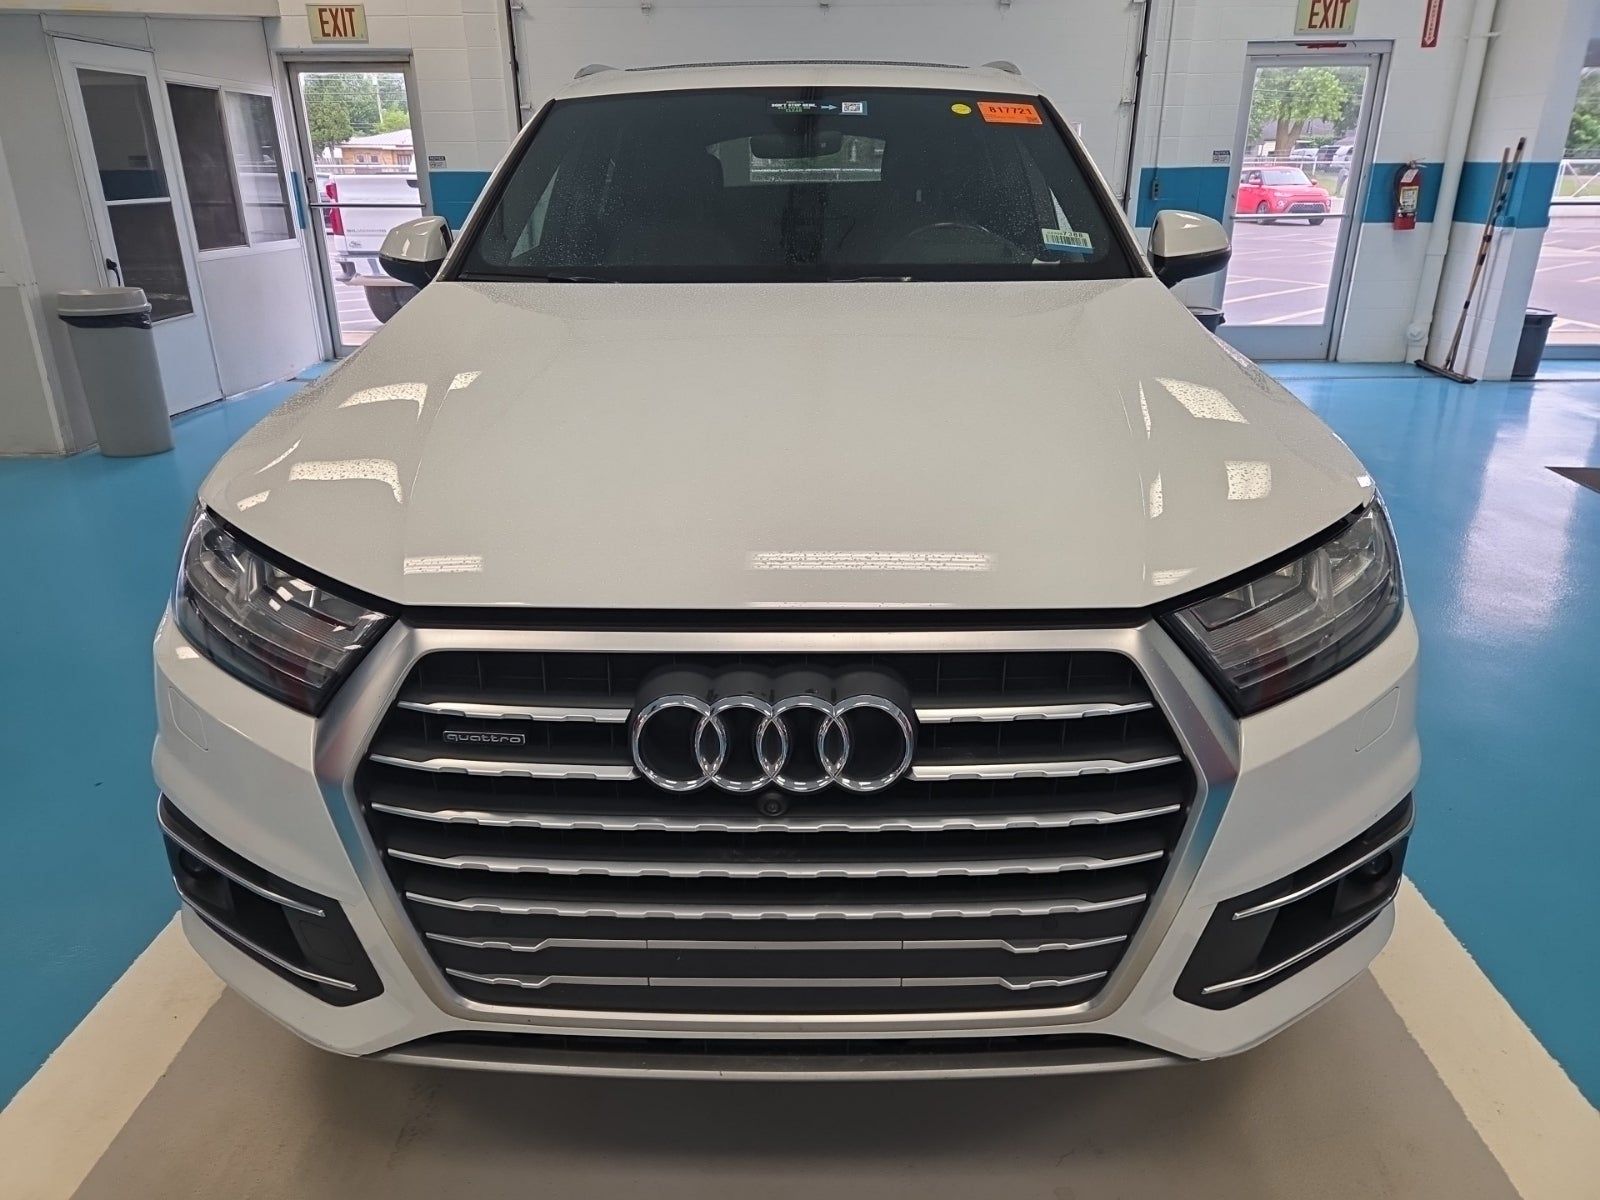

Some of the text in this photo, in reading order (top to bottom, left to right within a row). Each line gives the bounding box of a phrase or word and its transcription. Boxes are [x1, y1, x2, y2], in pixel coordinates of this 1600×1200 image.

[318, 7, 355, 37] EXIT
[1308, 0, 1351, 28] EXIT
[446, 733, 521, 743] quattro
